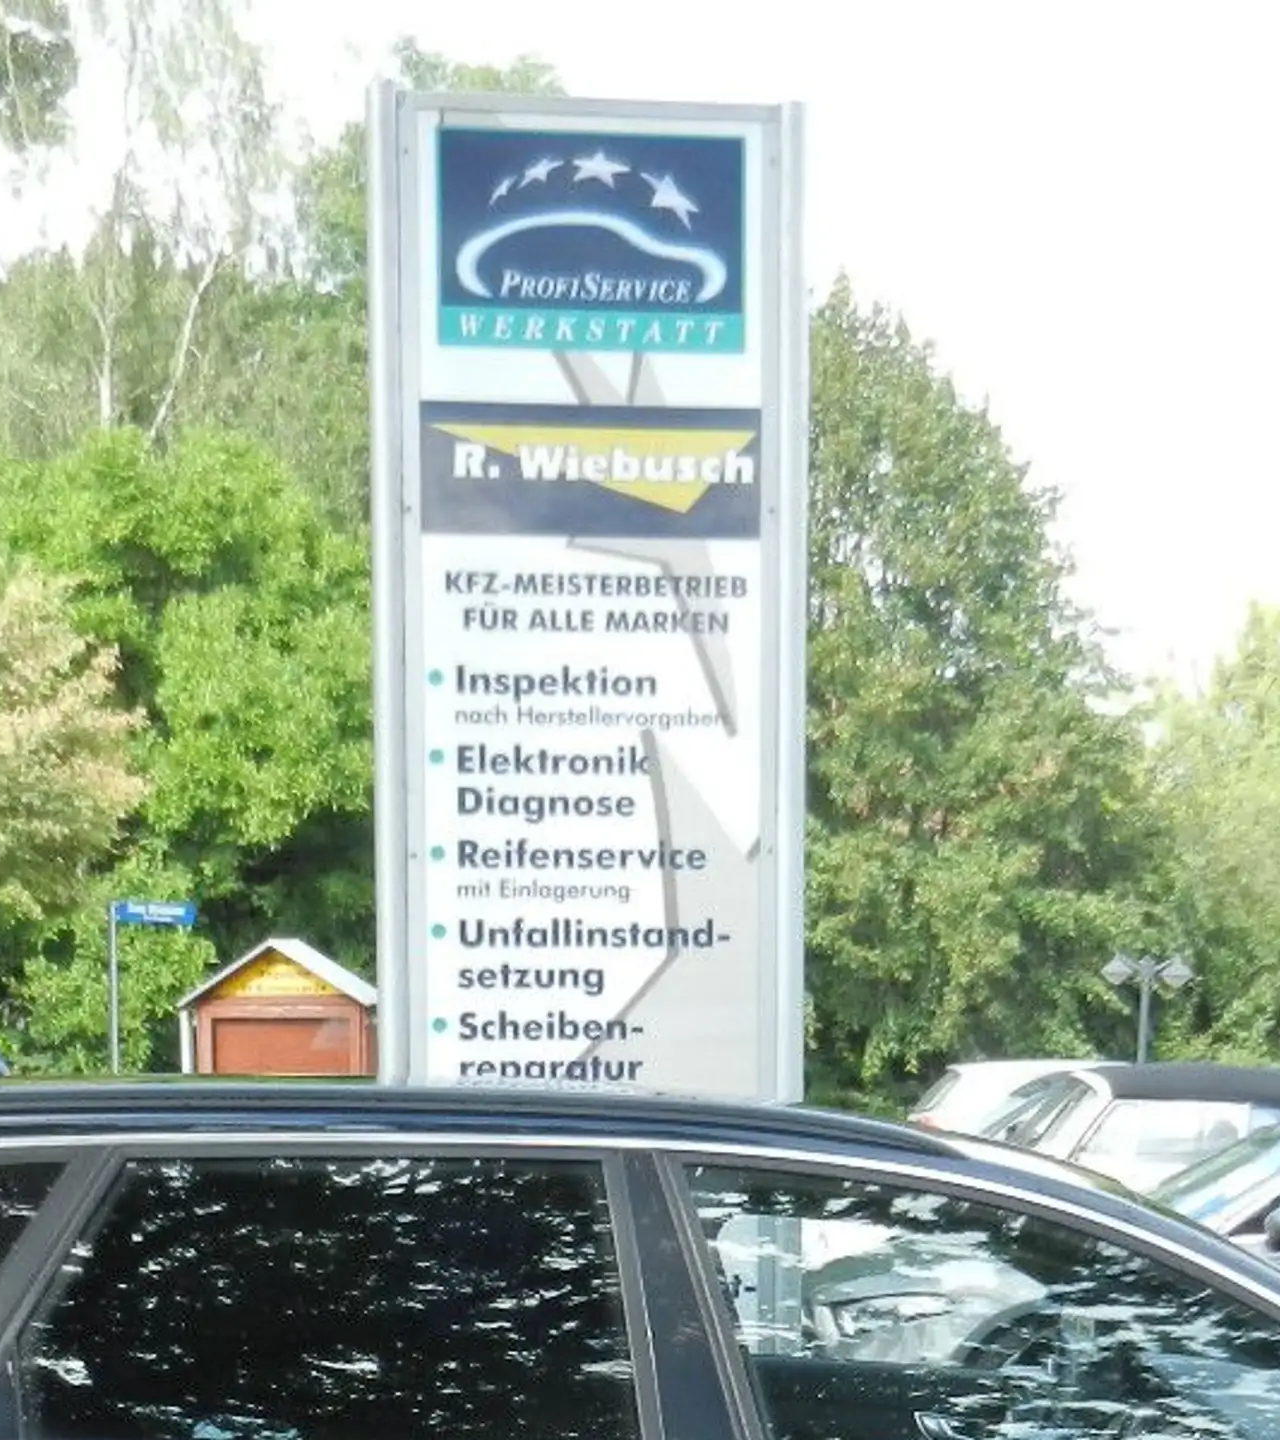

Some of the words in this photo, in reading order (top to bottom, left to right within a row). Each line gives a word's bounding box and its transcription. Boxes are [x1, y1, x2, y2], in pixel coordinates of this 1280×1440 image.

[458, 312, 725, 345] WERKSTATT
[452, 442, 500, 479] R.
[519, 444, 755, 484] Wiebusch
[445, 571, 748, 598] KFZ-MEISTERBETRIEB
[463, 602, 518, 631] FÜR
[528, 609, 595, 632] ALLE
[605, 610, 730, 634] MARKEN
[456, 665, 658, 702] Inspektion
[455, 705, 508, 726] nach
[458, 786, 635, 823] Diagnose
[458, 839, 706, 870] Reifenservice
[457, 878, 491, 899] mit
[499, 878, 631, 903] Einlagerung
[459, 918, 731, 949] Unfallinstand-
[458, 963, 605, 995] setzung
[459, 1010, 644, 1041] Scheiben-
